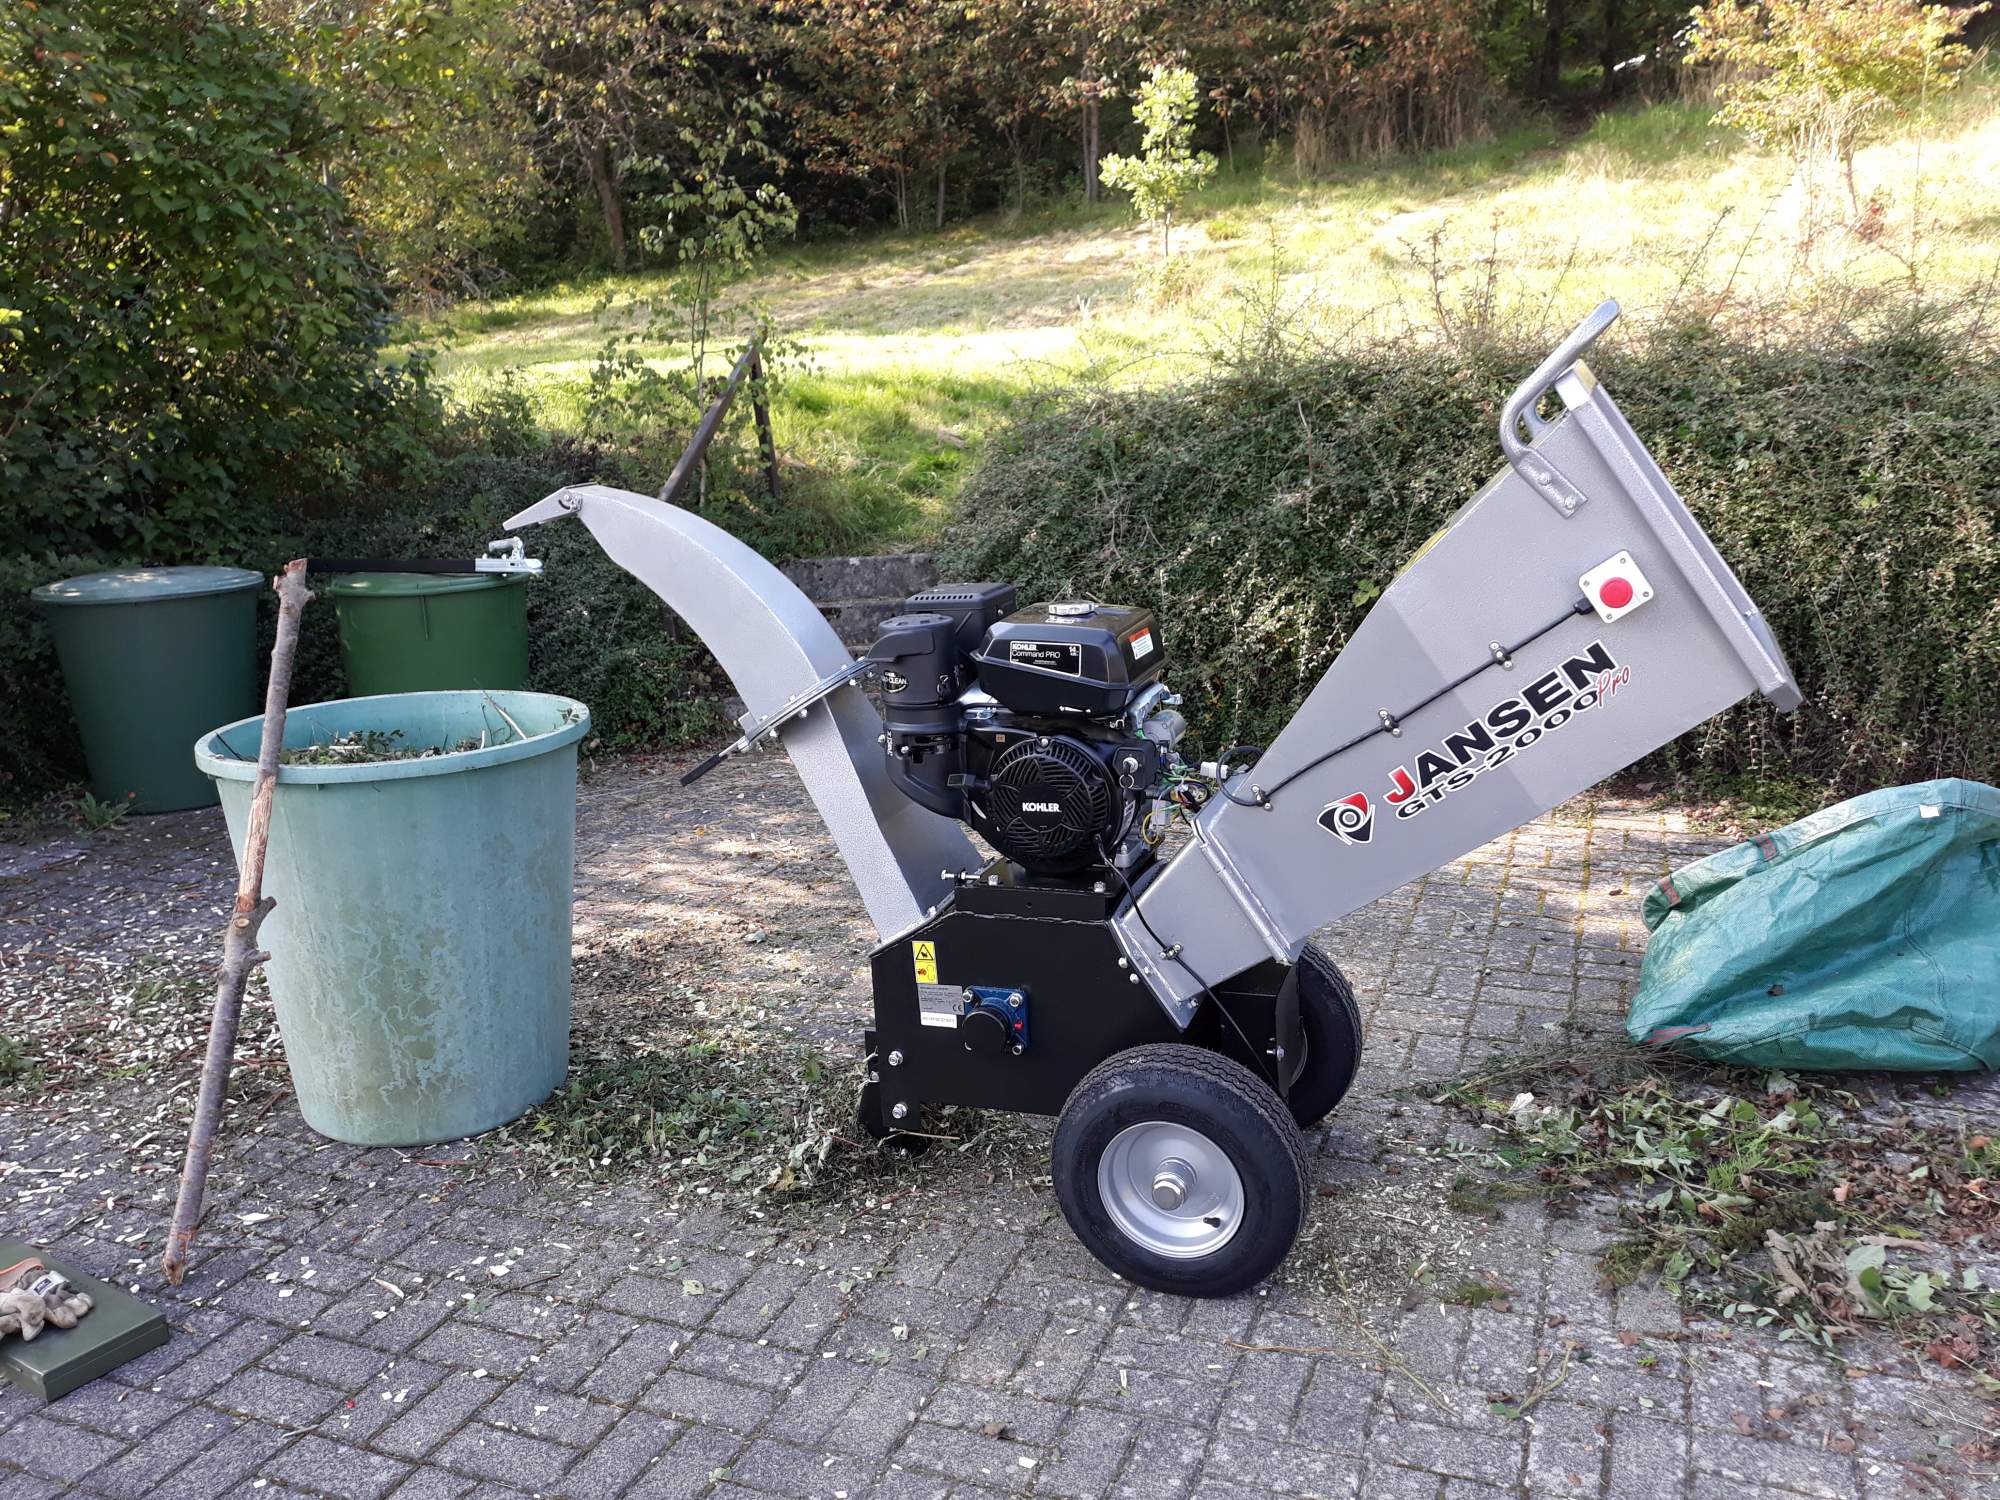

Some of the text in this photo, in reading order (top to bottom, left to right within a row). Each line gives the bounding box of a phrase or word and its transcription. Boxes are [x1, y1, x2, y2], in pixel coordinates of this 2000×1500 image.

[1011, 650, 1045, 658] Command
[1045, 651, 1061, 659] PRO
[1012, 643, 1038, 651] KOHLER
[1597, 666, 1630, 707] Pro
[1385, 641, 1618, 803] JANSEN
[1397, 690, 1599, 819] GTS-2000
[1022, 802, 1062, 812] KOHLER
